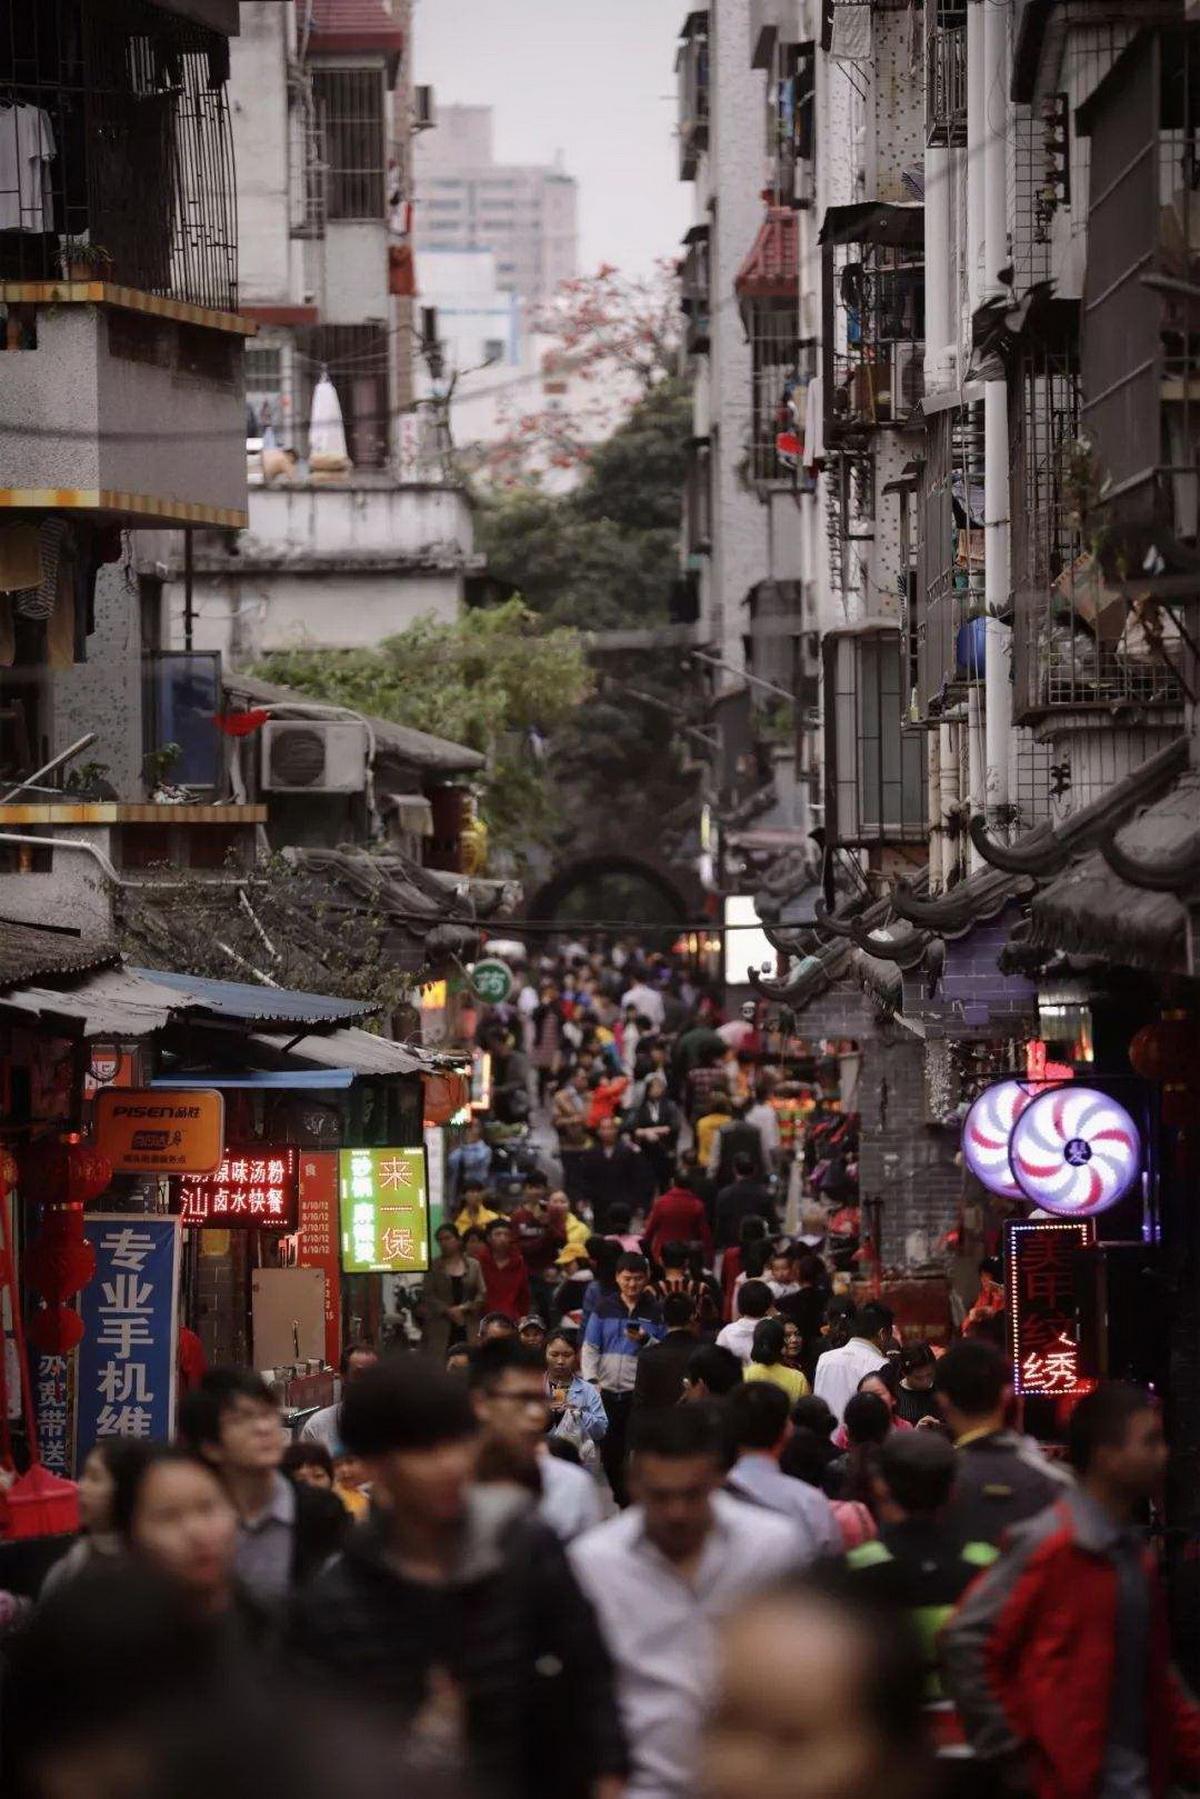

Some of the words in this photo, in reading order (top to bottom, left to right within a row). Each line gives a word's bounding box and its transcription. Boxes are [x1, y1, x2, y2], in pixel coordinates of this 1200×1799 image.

[113, 1106, 174, 1118] PISEN
[213, 1187, 284, 1214] 卤水快餐
[379, 1156, 414, 1261] 来一煲
[96, 1228, 157, 1438] 专业手机维
